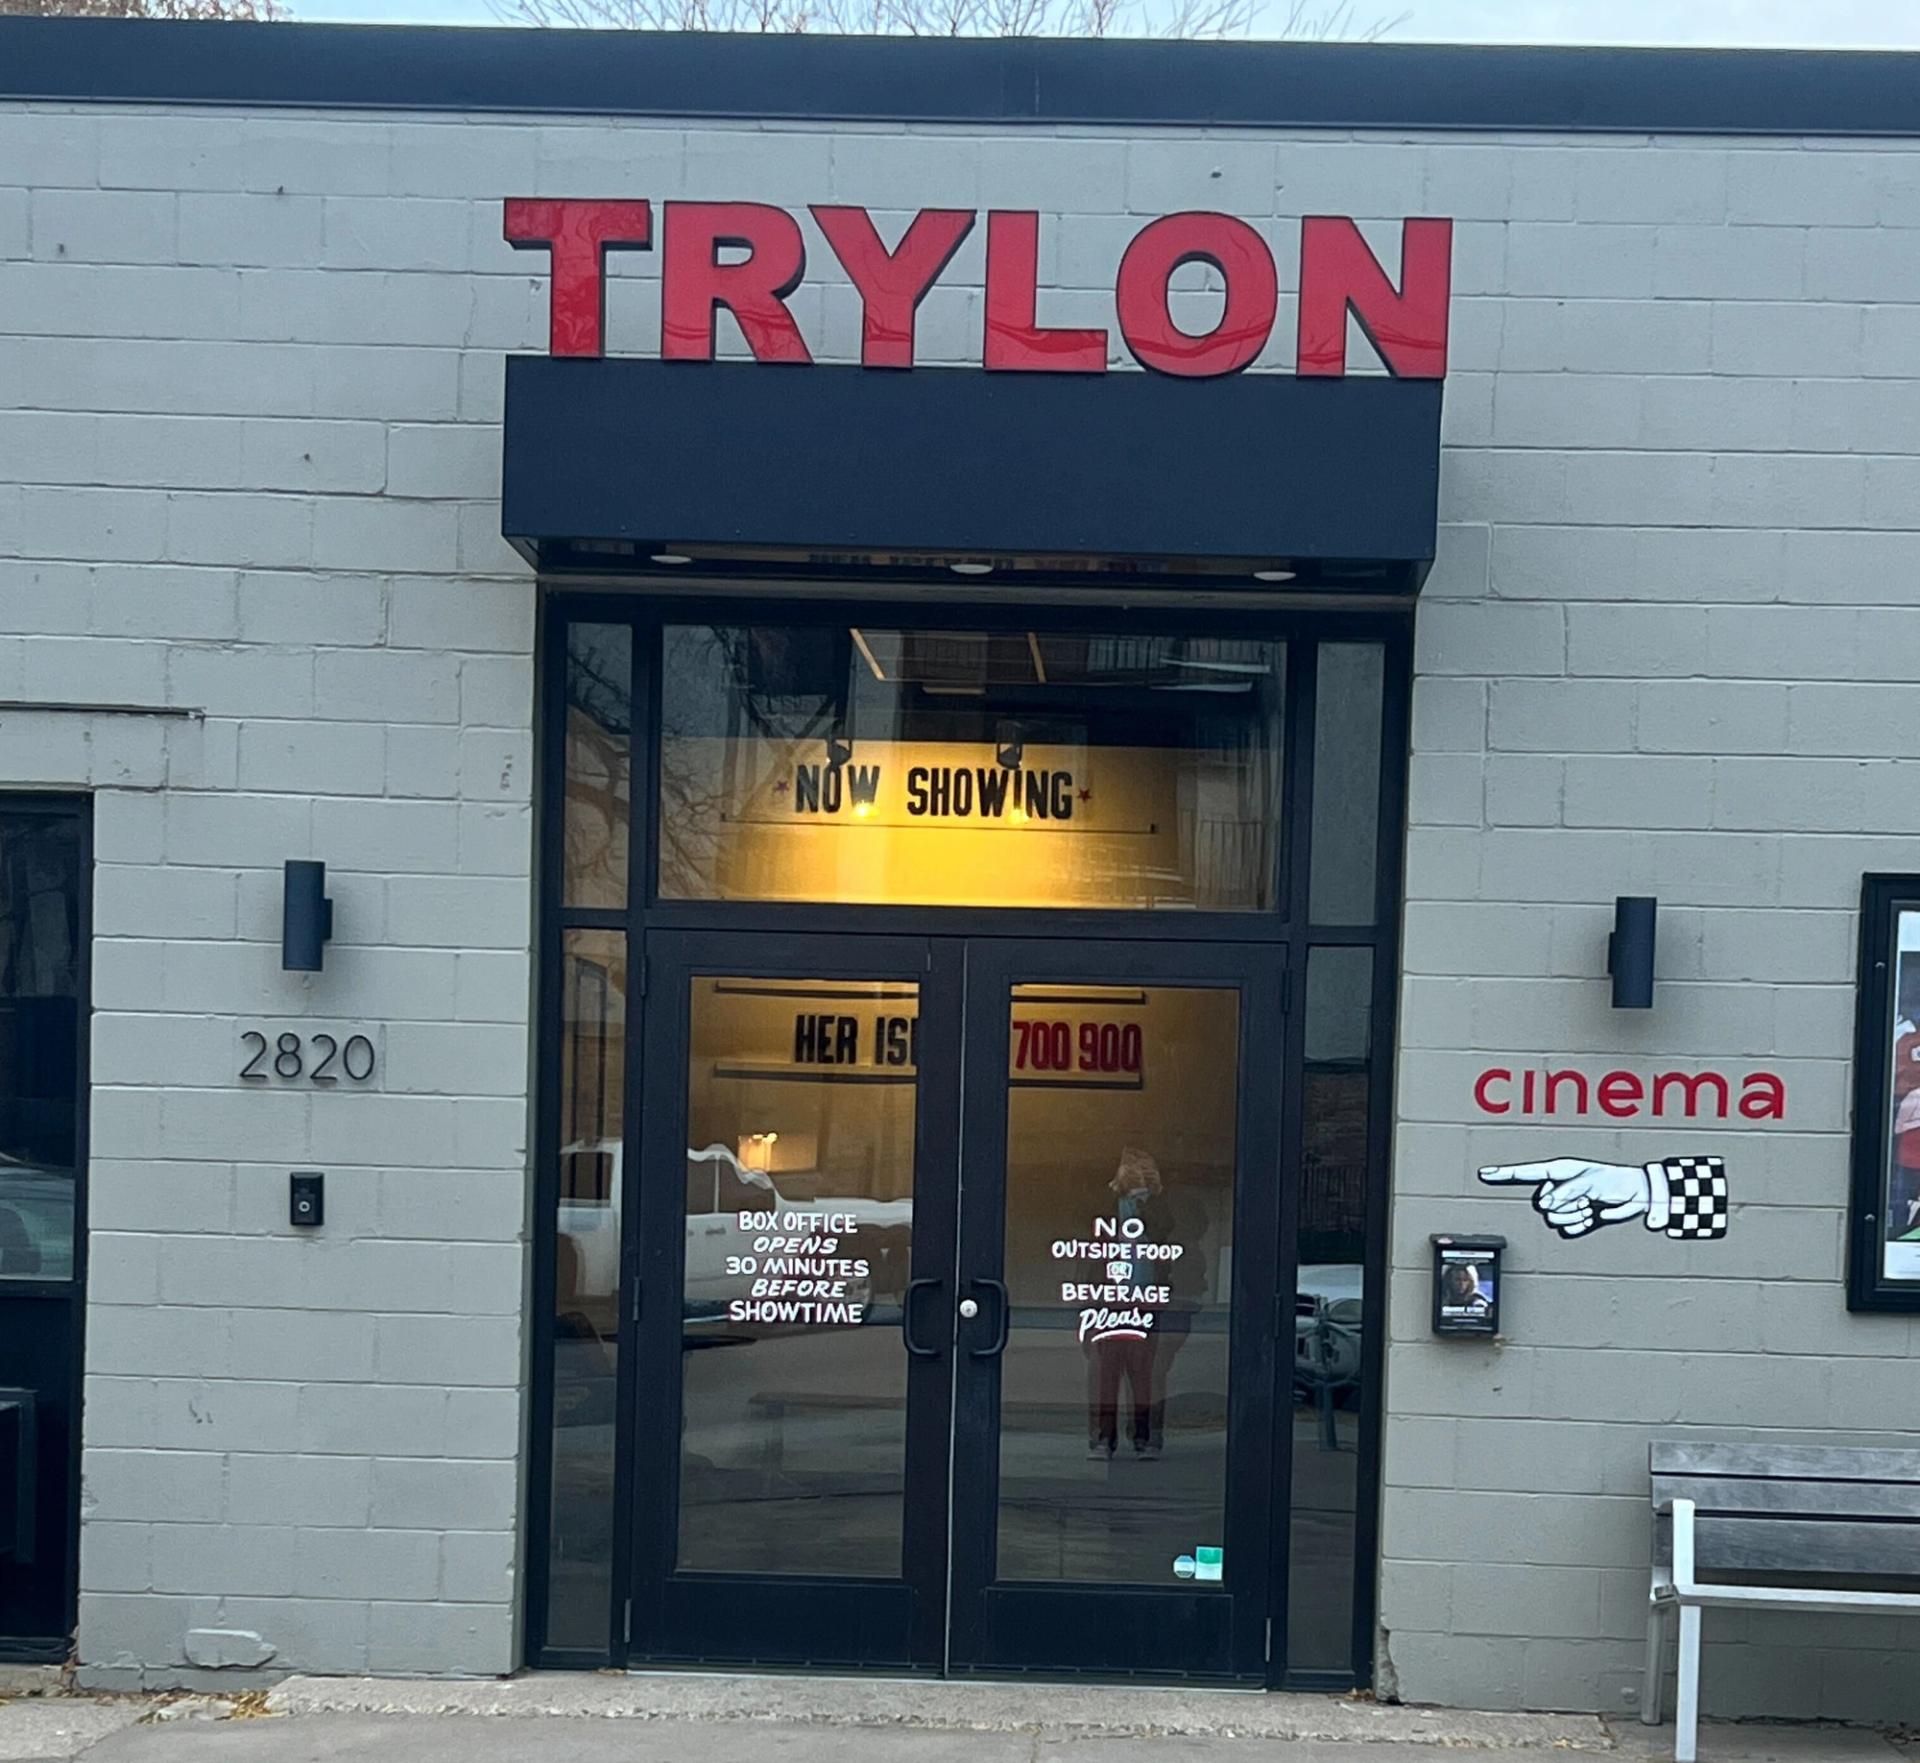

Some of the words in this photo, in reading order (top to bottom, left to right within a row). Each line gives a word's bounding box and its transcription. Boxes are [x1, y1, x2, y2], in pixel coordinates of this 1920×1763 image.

[503, 198, 1453, 379] TRYLON
[796, 764, 880, 813] NOW
[907, 767, 1073, 819] SHOWING
[794, 1014, 859, 1064] HER
[876, 1017, 918, 1066] IS
[1012, 1021, 1071, 1070] 700
[1079, 1023, 1142, 1073] 900
[239, 1031, 375, 1082] 2820
[1474, 1068, 1786, 1120] cinema
[739, 1211, 779, 1231] BOX
[783, 1212, 858, 1233] OFFICE
[1094, 1217, 1145, 1239] NO
[753, 1236, 838, 1255] OPENS
[1052, 1239, 1132, 1259] OUTSIDE
[1136, 1244, 1183, 1260] FOOD
[726, 1256, 758, 1275] 30
[763, 1258, 870, 1277] MINUTES
[751, 1278, 847, 1298] BEFORE
[1061, 1283, 1170, 1303] BEVERAGE
[729, 1300, 864, 1323] SHOWTIME
[1079, 1307, 1154, 1342] Please
